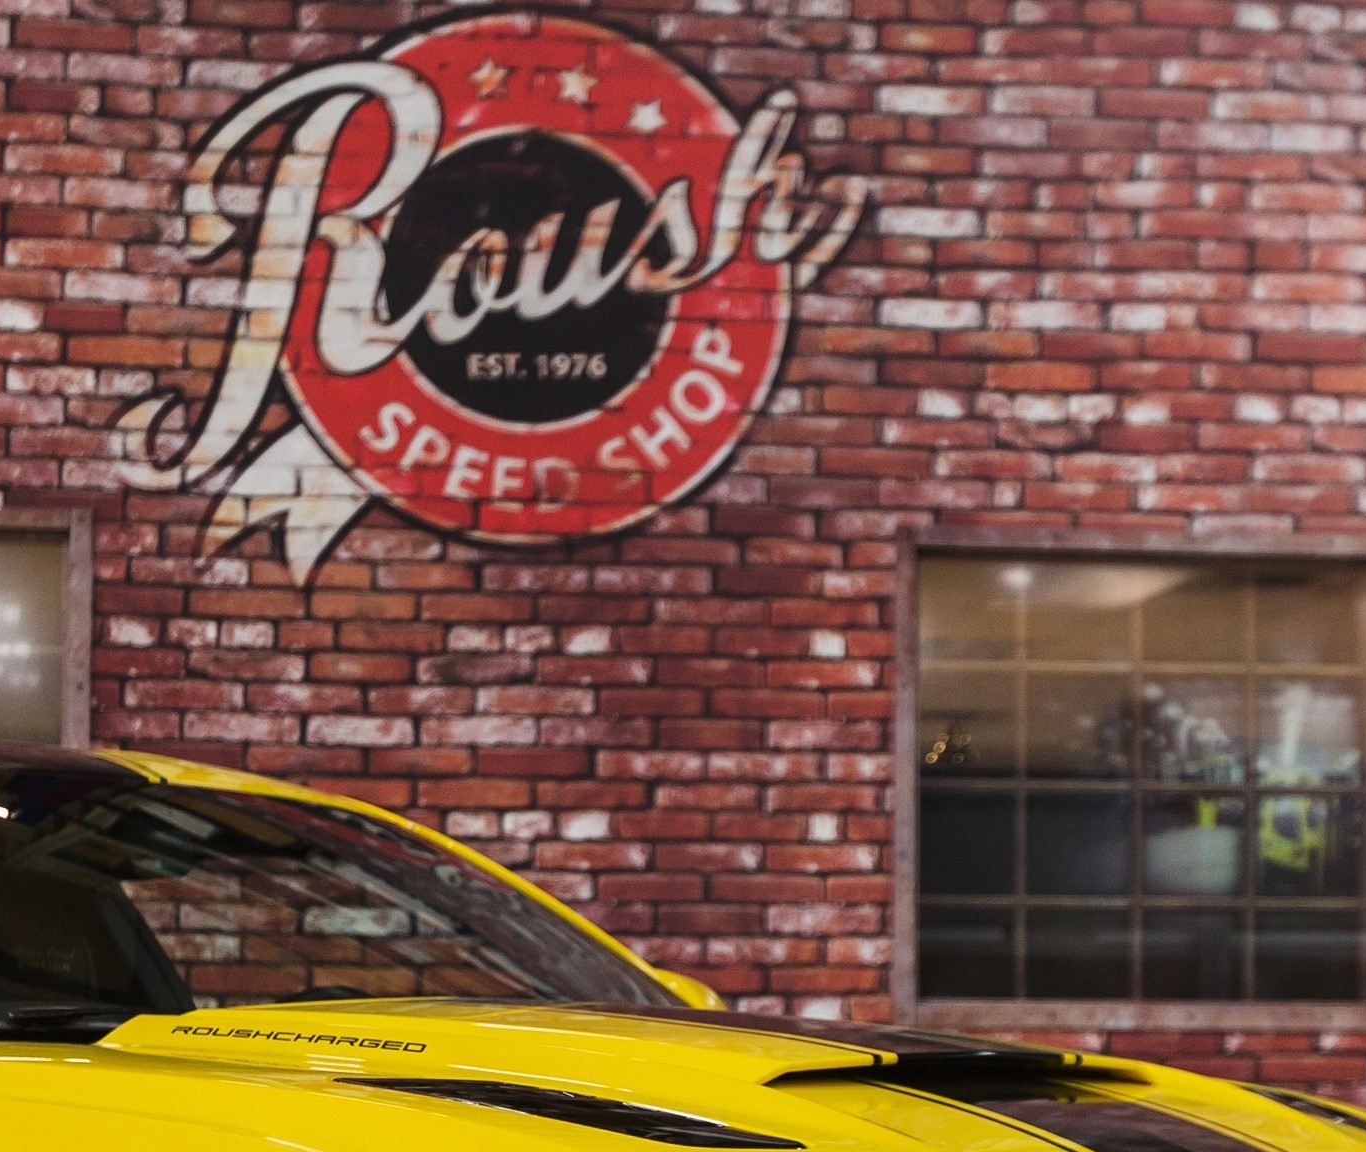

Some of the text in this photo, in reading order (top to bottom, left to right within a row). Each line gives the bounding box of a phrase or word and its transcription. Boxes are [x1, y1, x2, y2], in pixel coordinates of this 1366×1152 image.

[115, 59, 870, 490] Roush
[467, 352, 609, 380] EST. 1976
[358, 327, 745, 513] SPEED SHOP
[170, 1025, 428, 1054] ROUSHCHARGED
